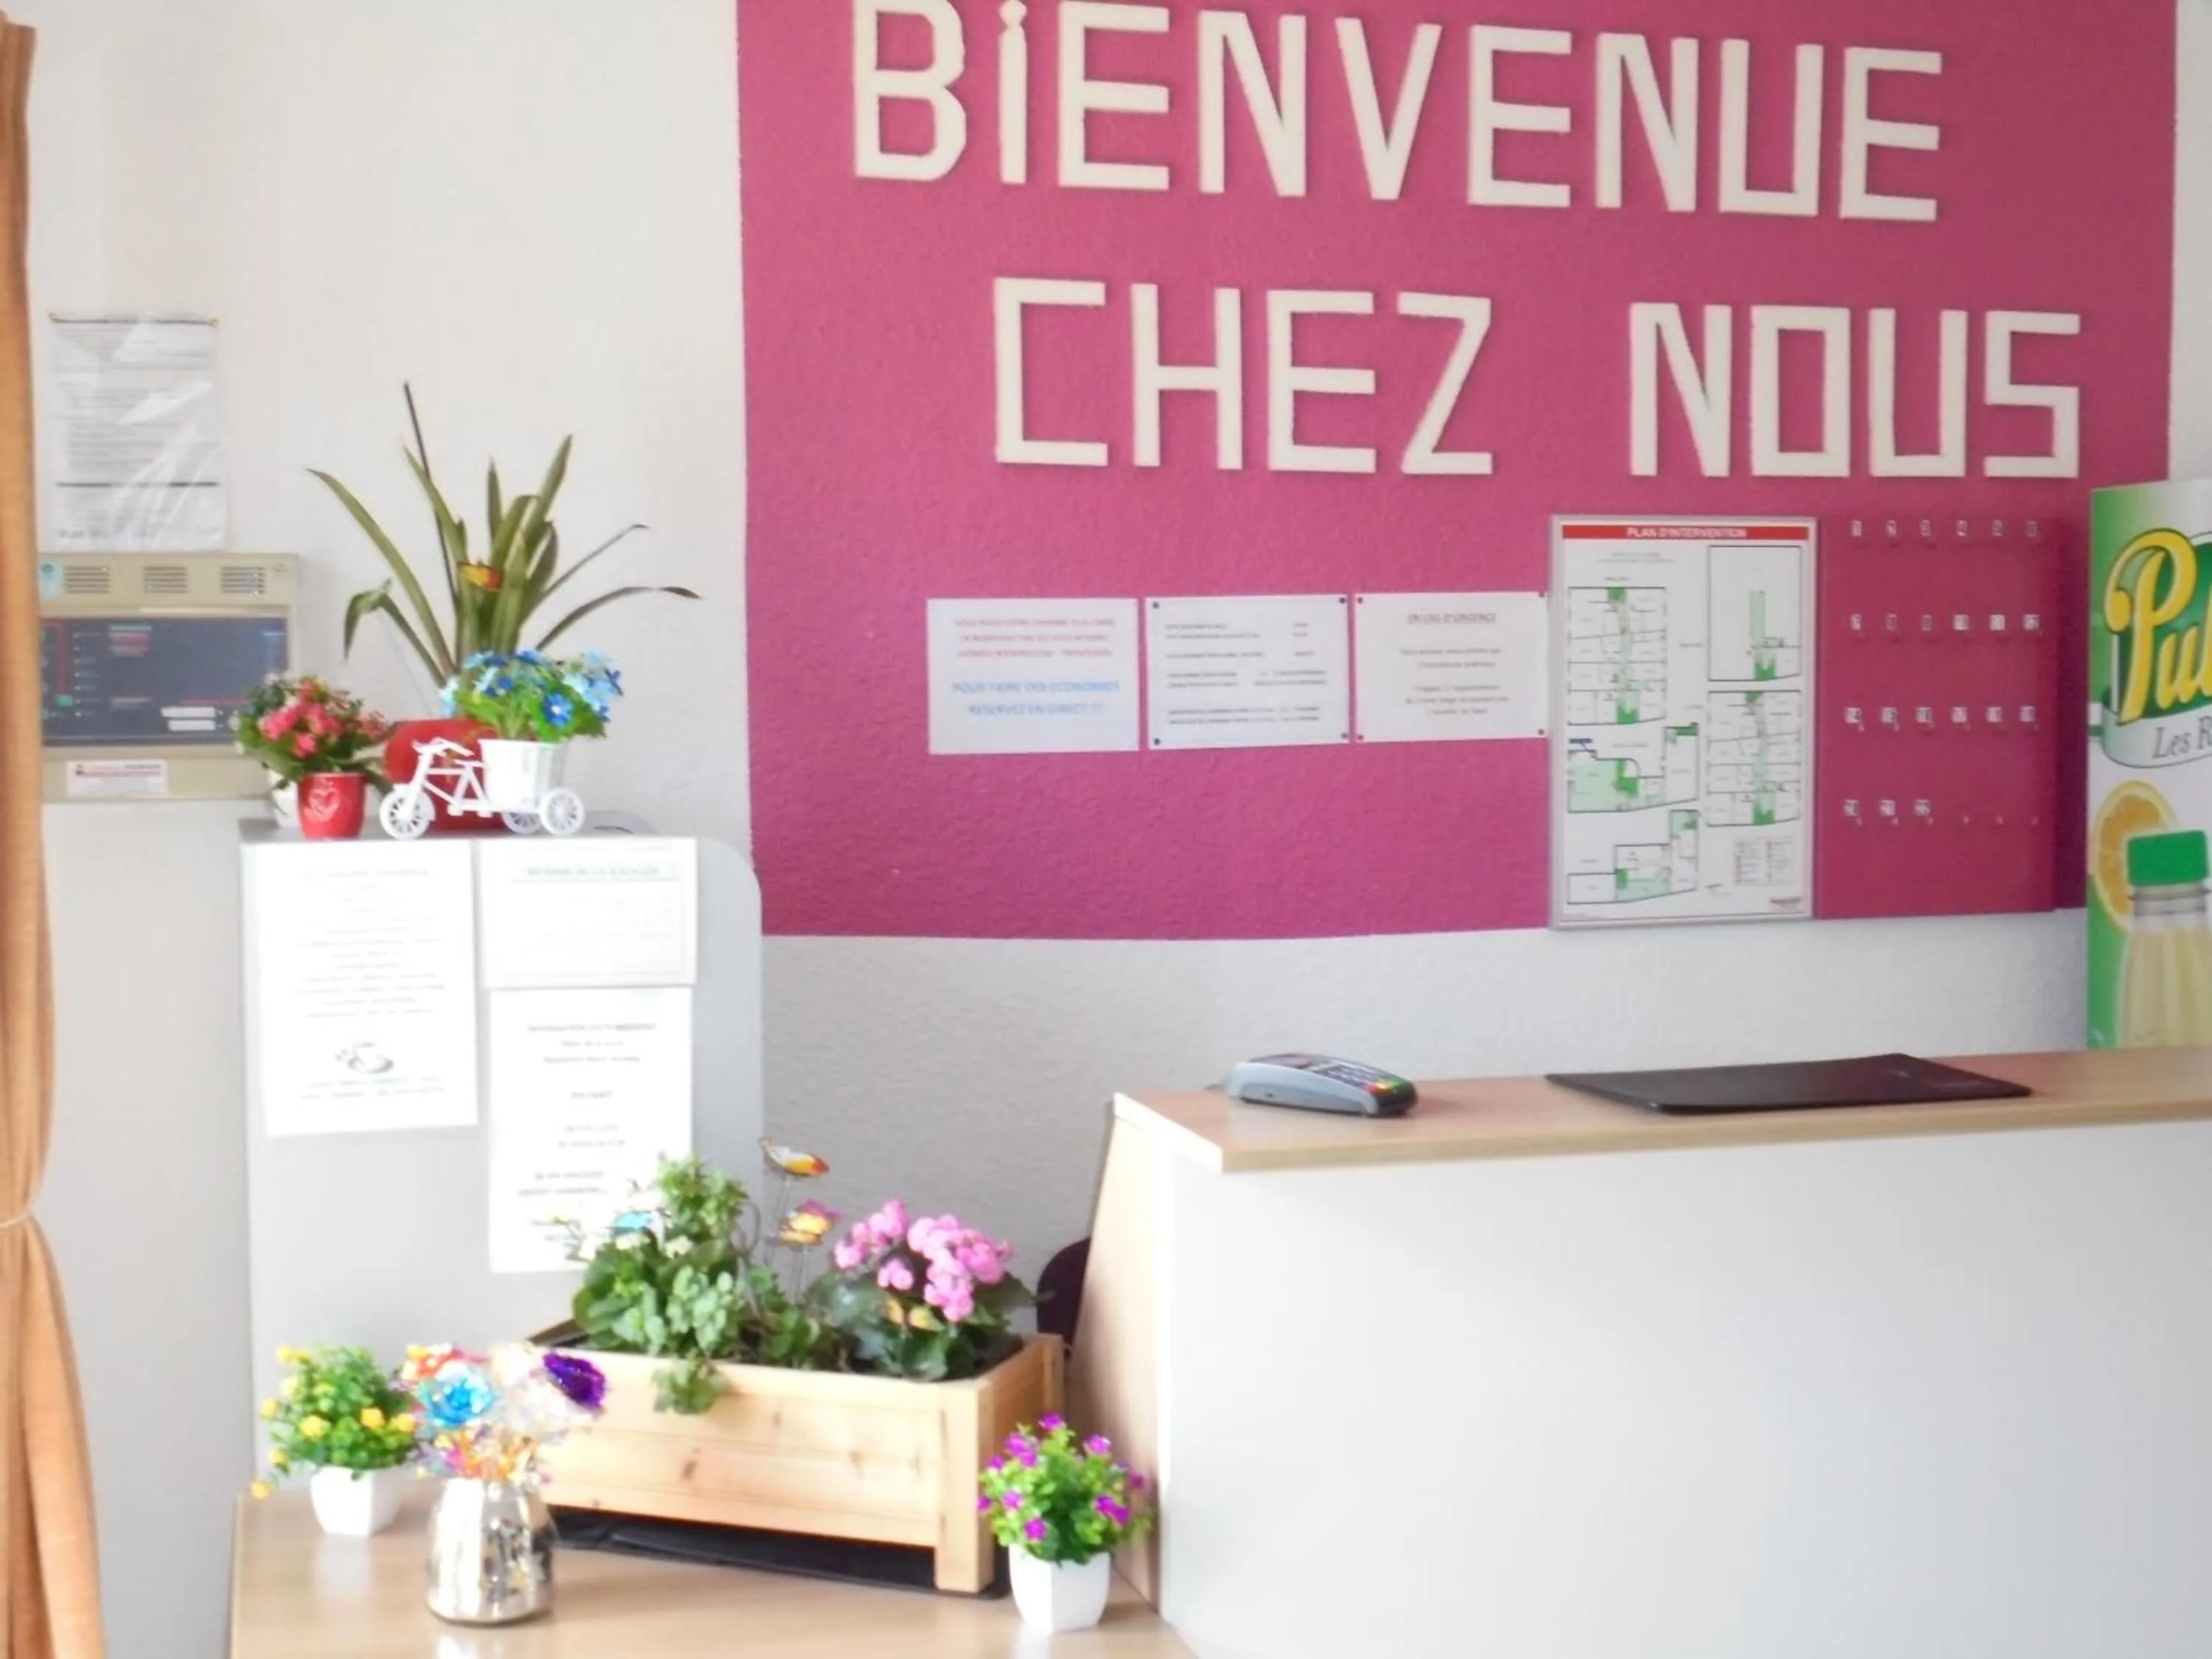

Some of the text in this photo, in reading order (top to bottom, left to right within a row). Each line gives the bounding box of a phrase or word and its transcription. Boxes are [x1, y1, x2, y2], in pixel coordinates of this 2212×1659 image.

[993, 276, 2081, 479] CHEZ NOUS
[1626, 526, 1658, 538] PLAN
[2152, 726, 2192, 759] Les
